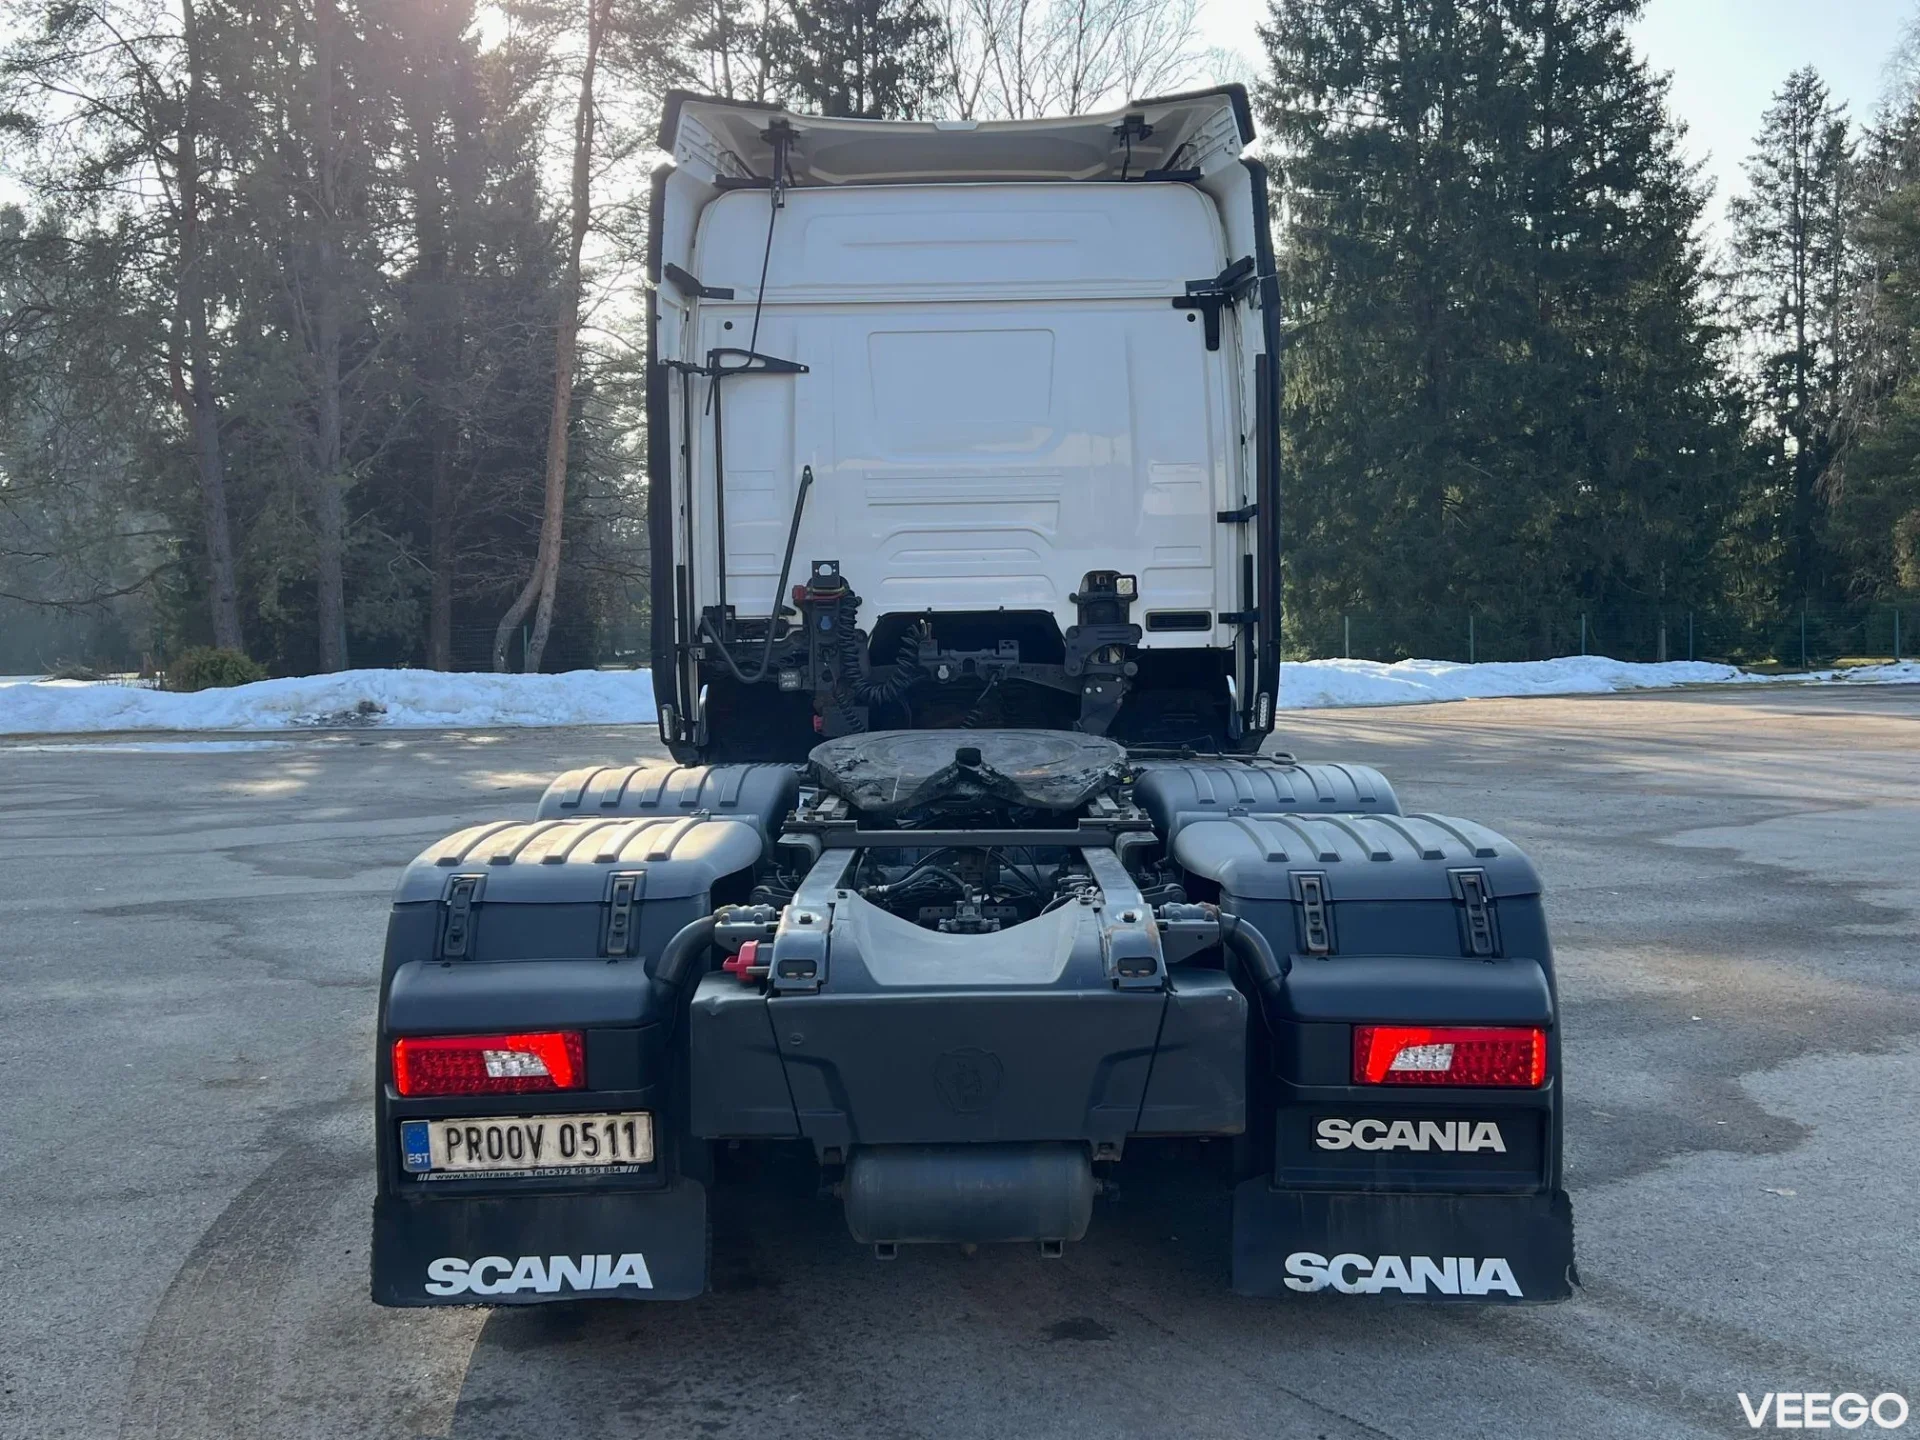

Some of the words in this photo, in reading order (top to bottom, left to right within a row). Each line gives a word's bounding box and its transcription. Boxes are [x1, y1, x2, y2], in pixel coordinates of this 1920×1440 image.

[446, 1124, 543, 1161] PROOV
[559, 1121, 636, 1158] 0511
[1315, 1118, 1506, 1152] SCANIA
[408, 1152, 429, 1164] EST
[424, 1253, 653, 1296] SCANIA
[1283, 1252, 1524, 1297] SCANIA
